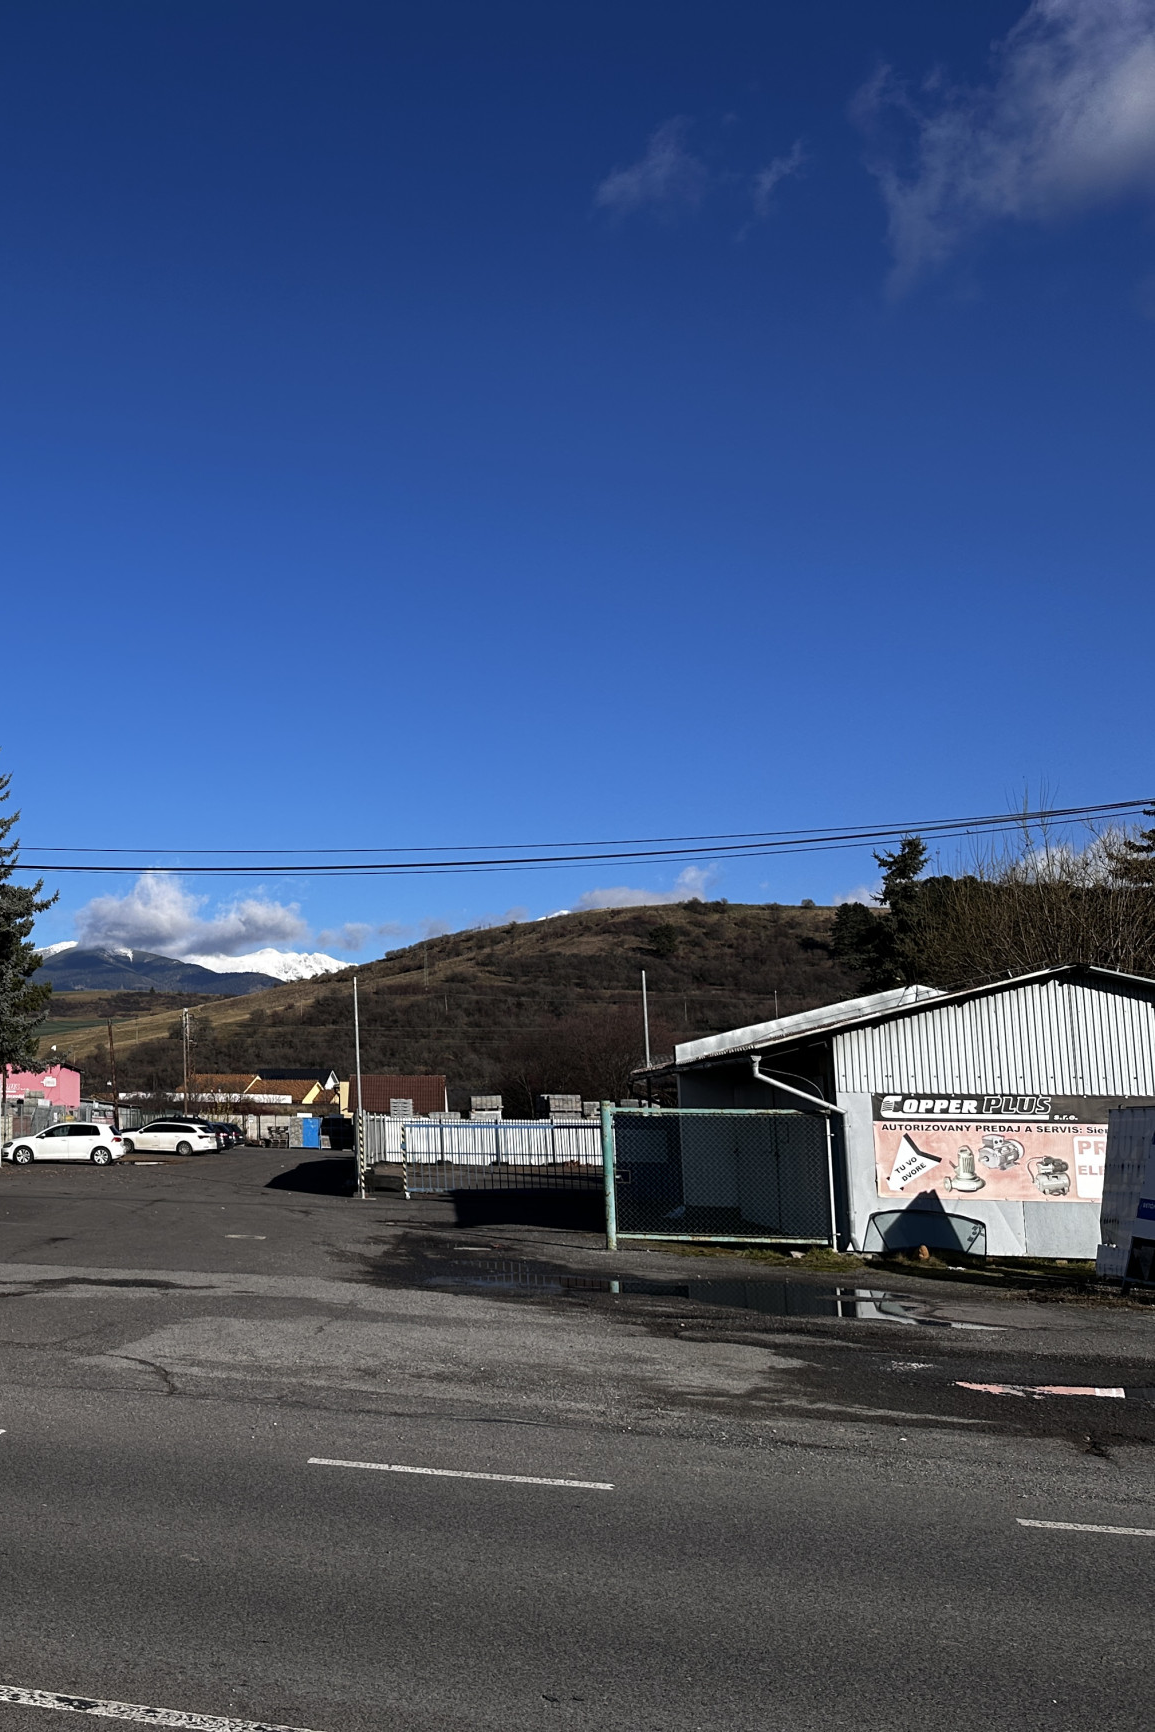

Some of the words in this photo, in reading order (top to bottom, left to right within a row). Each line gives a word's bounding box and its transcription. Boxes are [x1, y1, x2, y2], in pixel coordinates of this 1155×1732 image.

[880, 1095, 978, 1119] COPPER
[982, 1096, 1052, 1115] PLUS
[881, 1123, 972, 1132] AUTORIZOVANY
[975, 1124, 1021, 1133] PREDAJ
[1024, 1125, 1033, 1133] A
[1036, 1125, 1083, 1134] SERVIS:
[894, 1164, 906, 1174] TU
[905, 1156, 918, 1166] VO
[901, 1162, 927, 1182] DVORE
